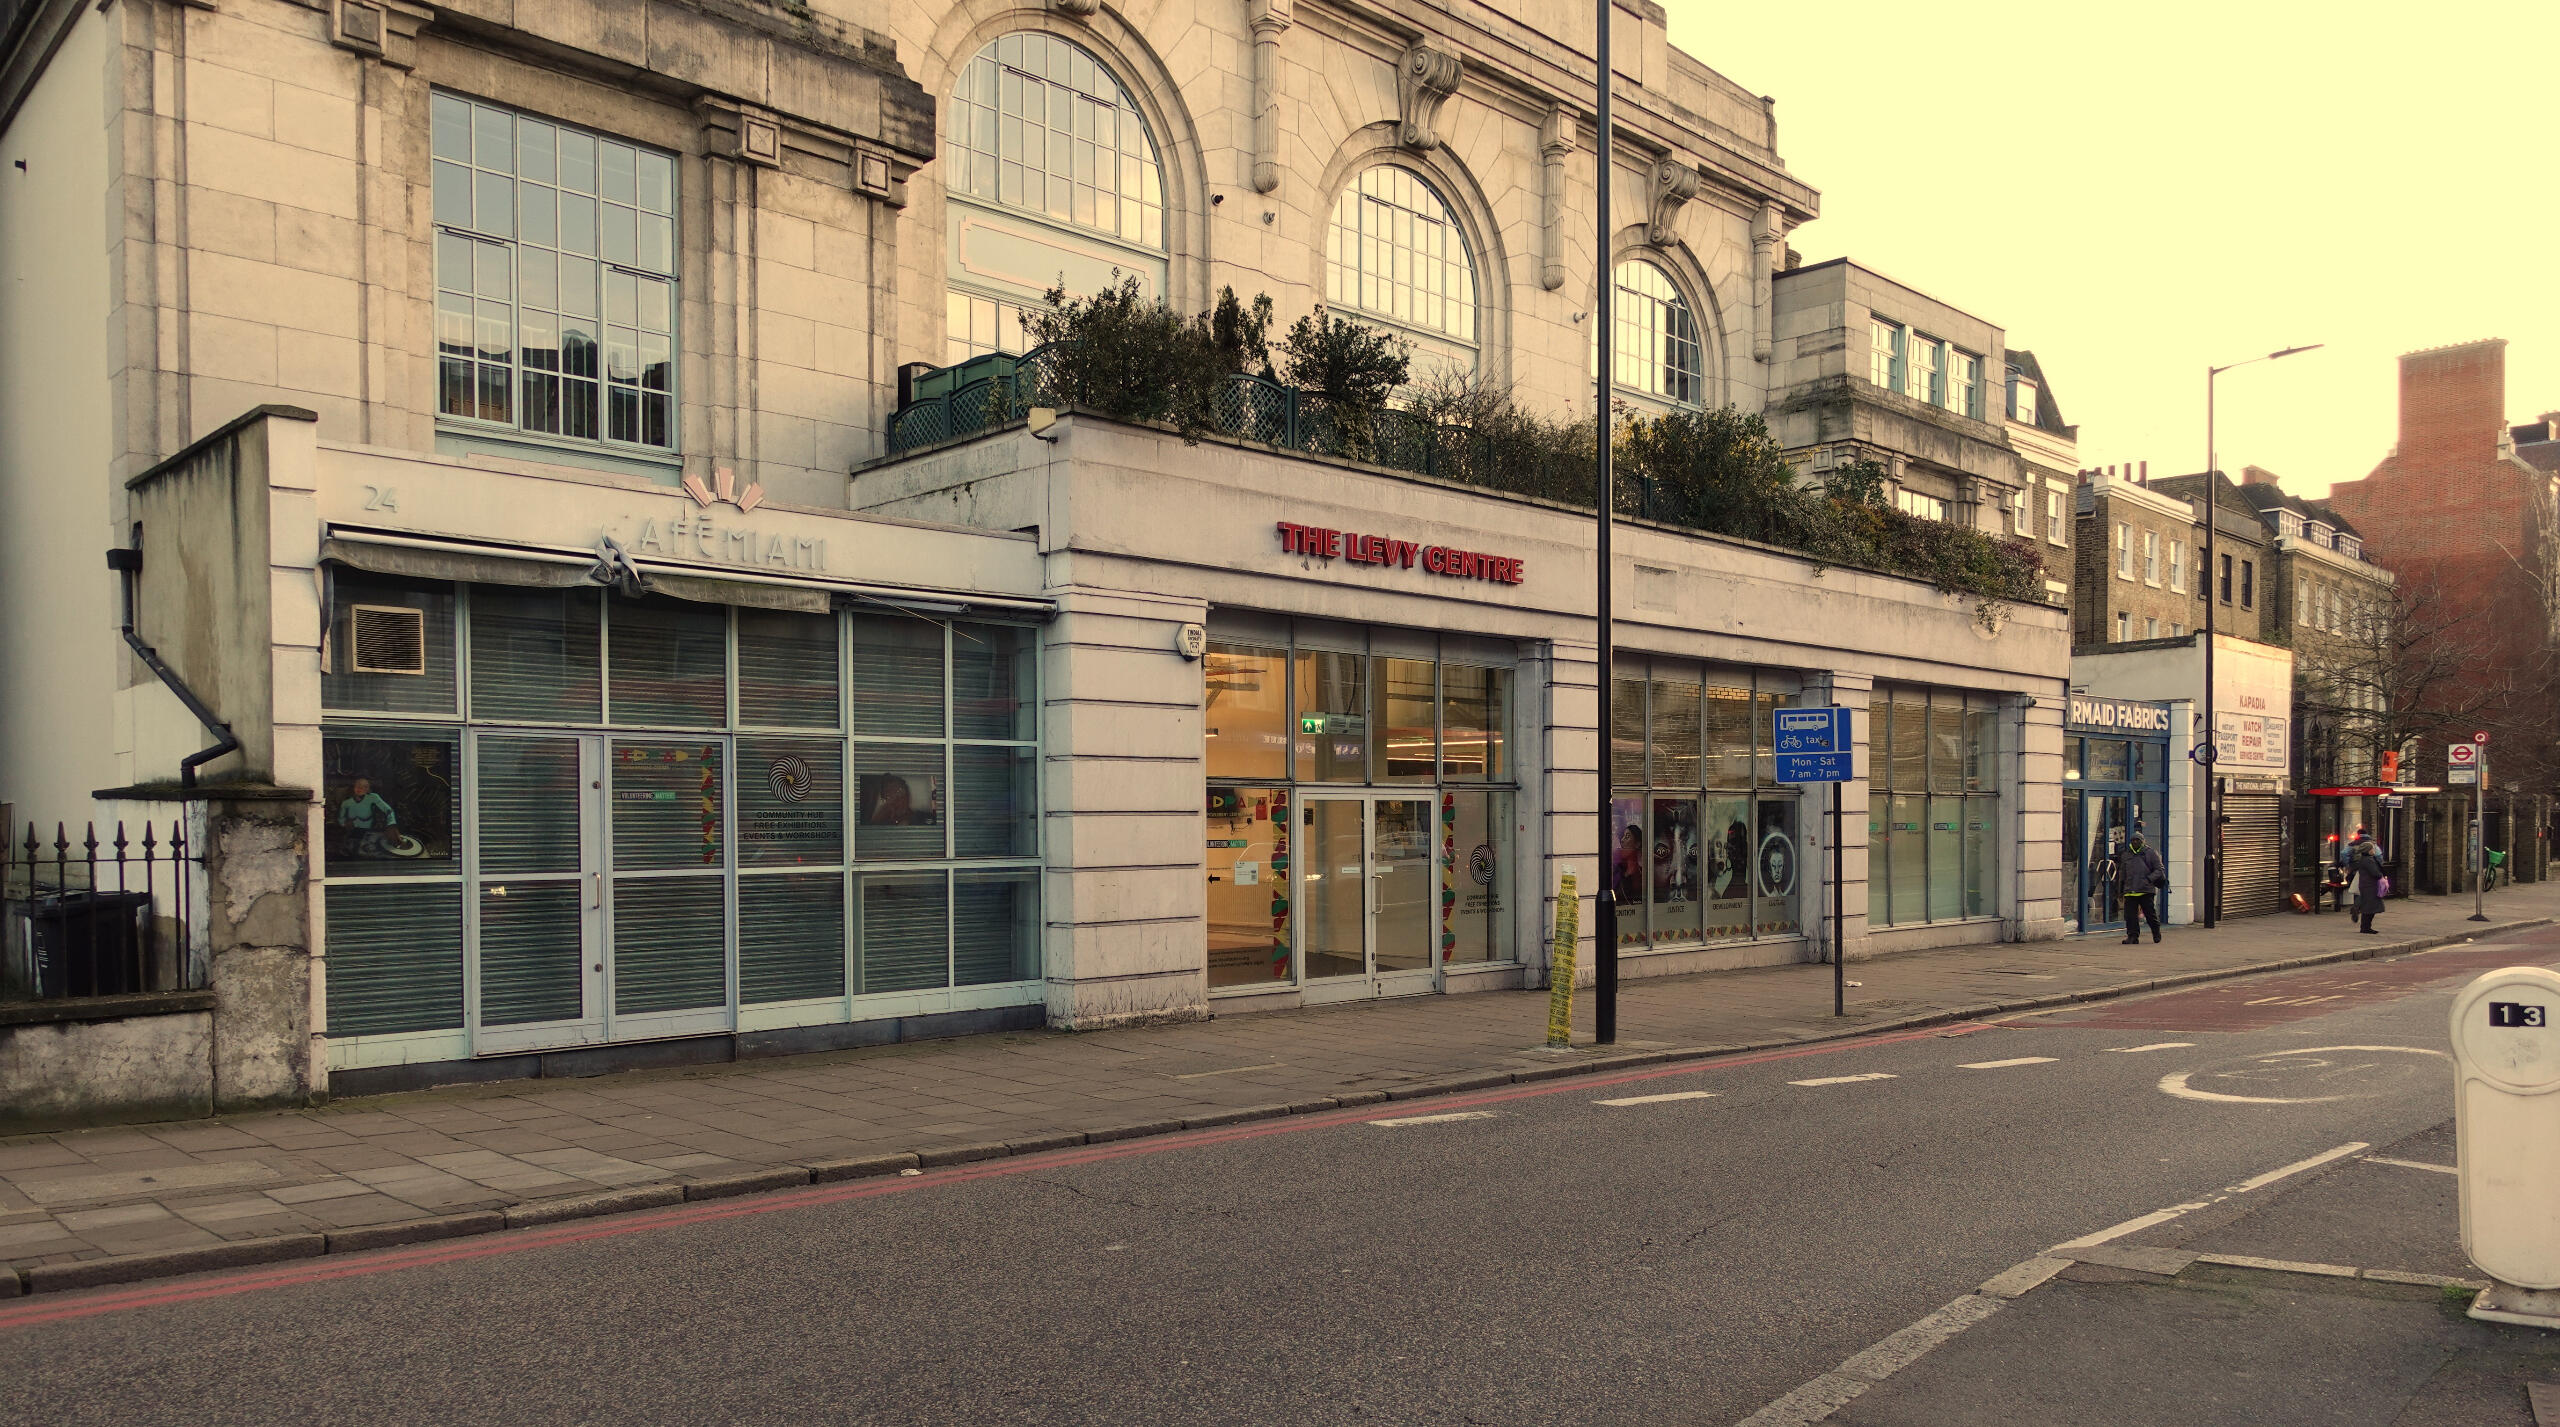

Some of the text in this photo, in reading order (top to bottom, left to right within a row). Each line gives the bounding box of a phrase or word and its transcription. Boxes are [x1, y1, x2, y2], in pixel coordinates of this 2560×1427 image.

[362, 485, 398, 513] 24
[726, 526, 827, 571] MIAMI
[1277, 521, 1524, 584] THE LEVY CENTRE
[2239, 695, 2266, 710] KAPADIA
[2072, 701, 2169, 731] RMAID FABRICS
[2243, 721, 2262, 733] WATCH
[2242, 735, 2262, 748] REPAIR
[2220, 743, 2236, 753] PHOTO
[1791, 758, 1812, 766] Mon
[1819, 756, 1836, 766] Sat
[1789, 769, 1796, 778] 7
[1818, 768, 1824, 777] 7
[1826, 770, 1840, 778] pm
[756, 811, 824, 819] COMMUNITY HUB
[754, 821, 828, 830] FREE EXHIBITIONS
[743, 832, 776, 840] EVENTS
[785, 831, 840, 840] WORKSHOPS
